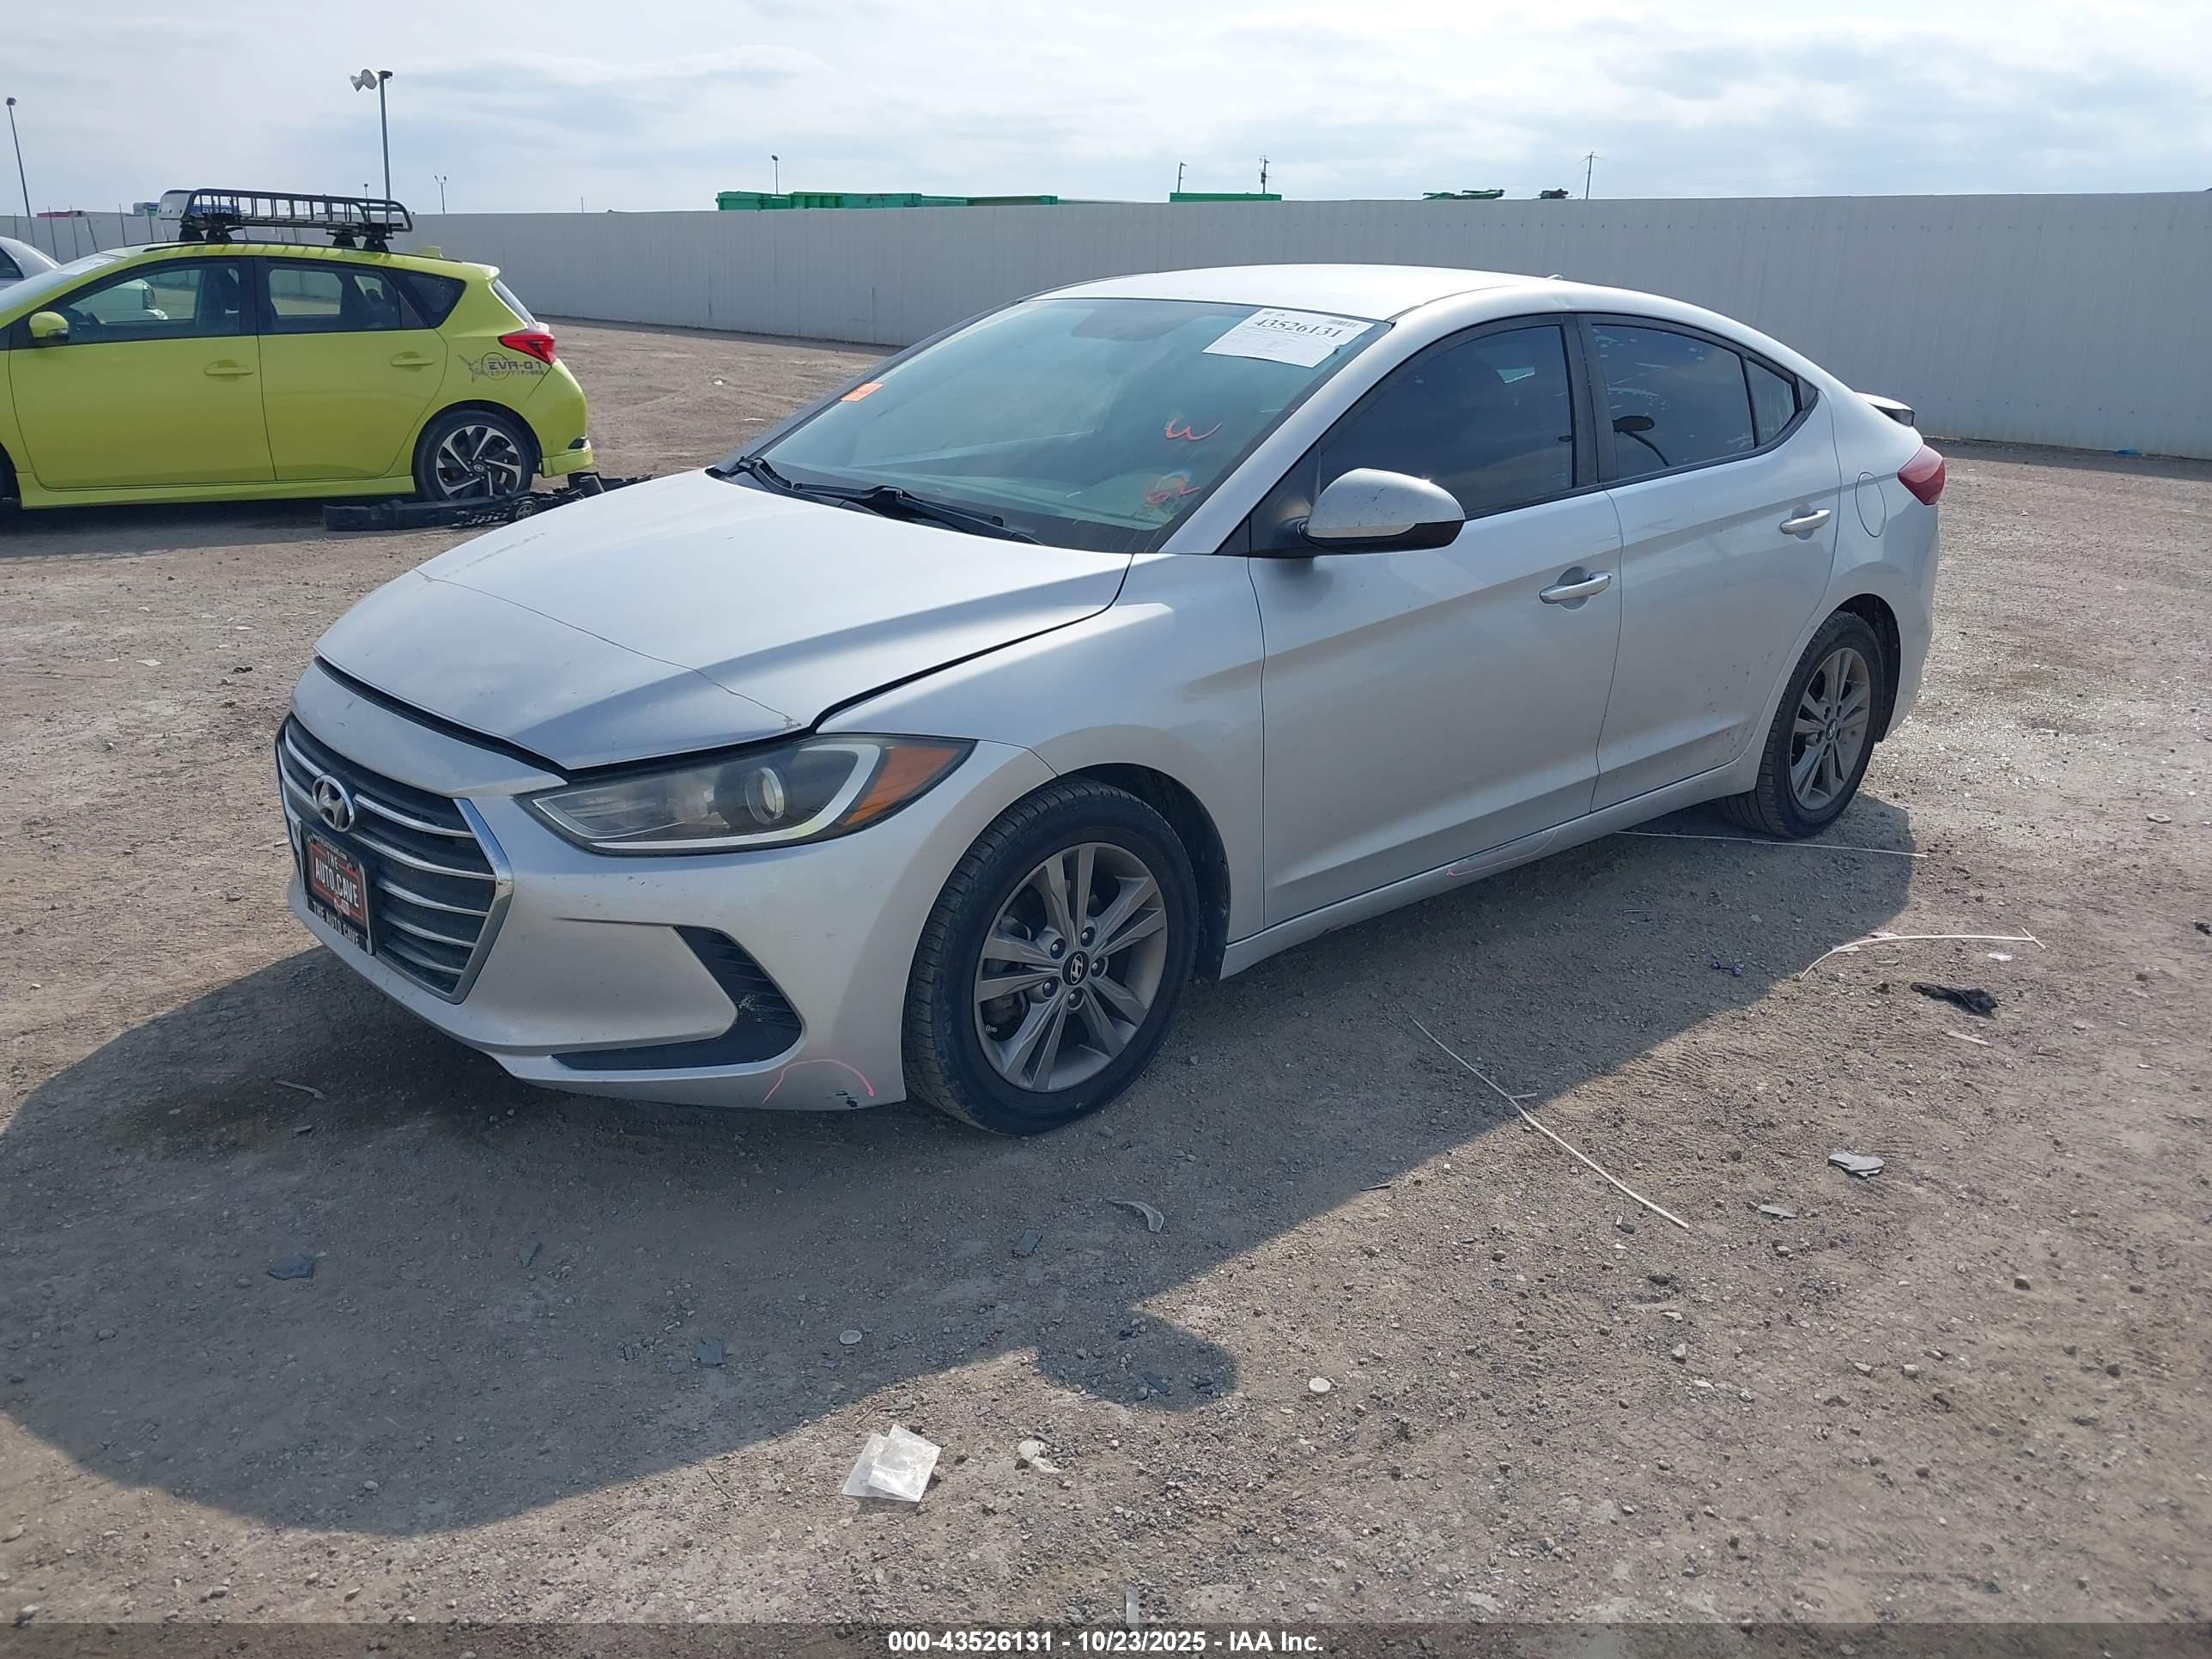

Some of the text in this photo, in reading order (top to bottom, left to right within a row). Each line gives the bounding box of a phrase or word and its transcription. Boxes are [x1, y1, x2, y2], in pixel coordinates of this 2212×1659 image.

[1254, 318, 1344, 337] 43526131
[326, 851, 338, 870] THE
[315, 858, 335, 890] AUTO
[336, 873, 360, 908] CAVE
[313, 902, 325, 921] THE
[325, 911, 342, 933] AUTO
[343, 923, 360, 945] CAVE
